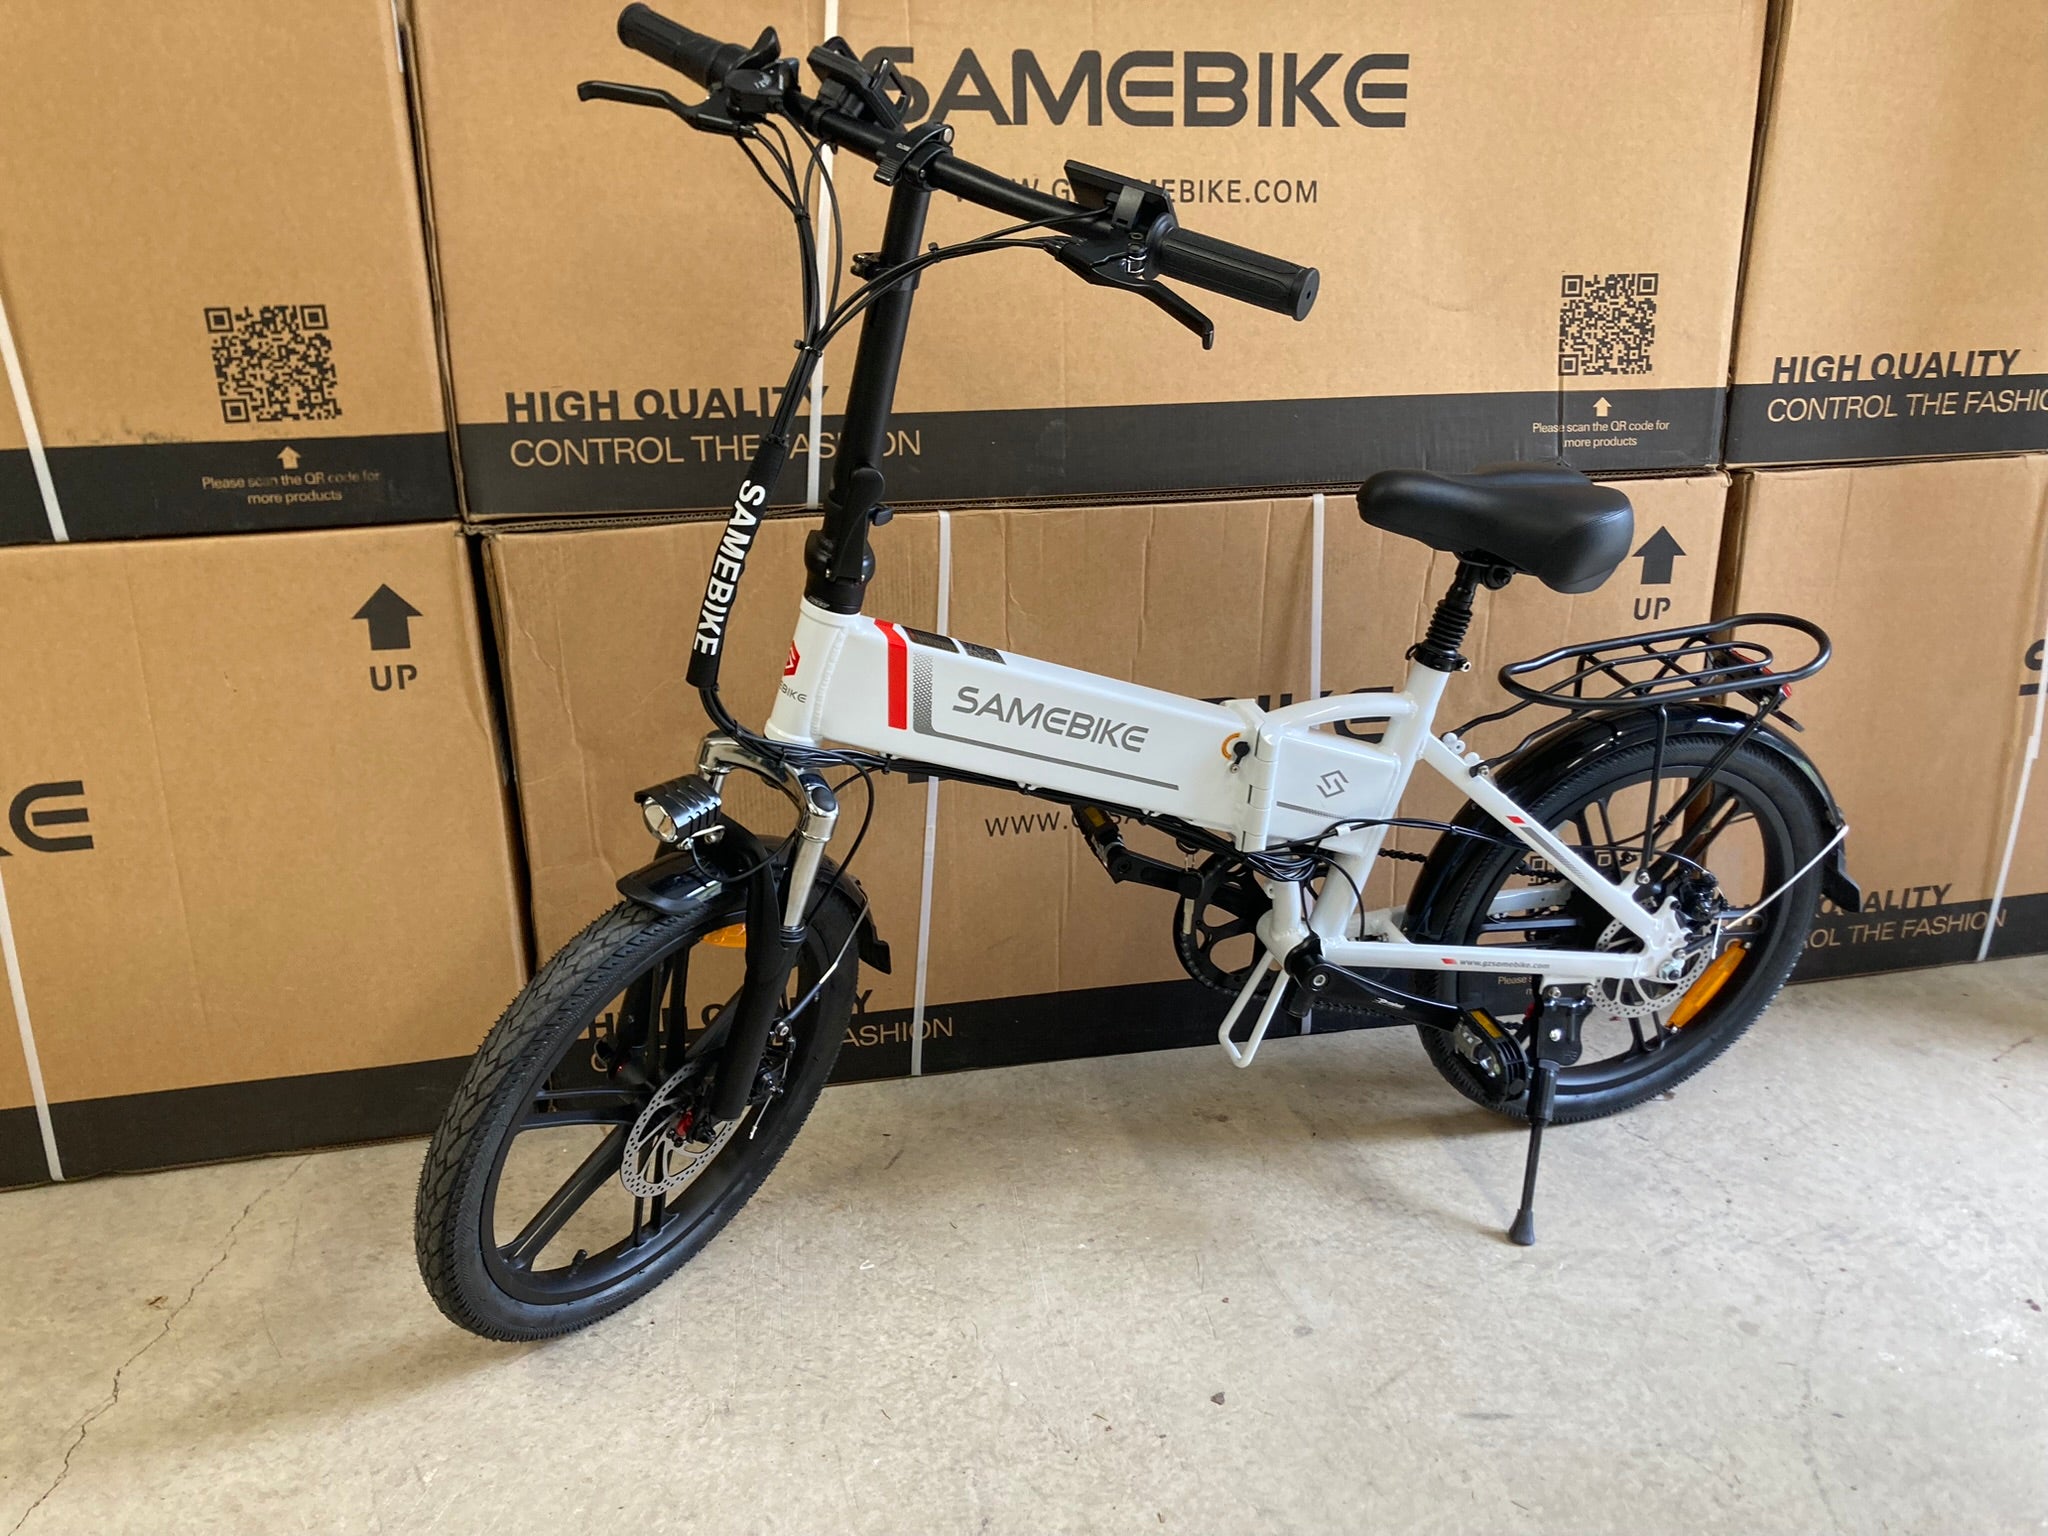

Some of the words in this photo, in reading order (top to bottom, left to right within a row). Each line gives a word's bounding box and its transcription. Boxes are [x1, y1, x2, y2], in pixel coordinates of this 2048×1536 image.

[862, 45, 1410, 129] SAMEBIKE
[1772, 354, 1861, 384] HIGH
[1871, 349, 2021, 381] QUALITY
[505, 389, 620, 423] HIGH
[1767, 394, 1899, 423] CONTROL
[1906, 391, 1960, 417] THE
[1532, 422, 1565, 433] Please
[1566, 423, 1590, 433] scan
[1592, 421, 1608, 432] the
[1610, 420, 1627, 432] QR
[1628, 420, 1654, 431] code
[1655, 419, 1670, 431] for
[510, 437, 684, 467] CONTROL
[691, 435, 760, 462] THE
[1563, 439, 1591, 448] more
[1593, 436, 1638, 449] products
[201, 476, 245, 490] Please
[247, 476, 278, 489] scan
[281, 473, 301, 487] the
[304, 472, 326, 486] QR
[327, 471, 359, 484] code
[362, 470, 380, 482] for
[247, 493, 282, 505] more
[285, 490, 343, 505] products
[693, 479, 766, 657] SAMEBIKE
[1633, 597, 1671, 621] UP
[369, 664, 417, 692] UP
[952, 686, 1150, 753] SAMEBIKE
[1848, 921, 1895, 944] THE
[1901, 909, 2007, 939] FASHION
[1497, 976, 1528, 985] Please
[843, 1017, 953, 1047] ASHION
